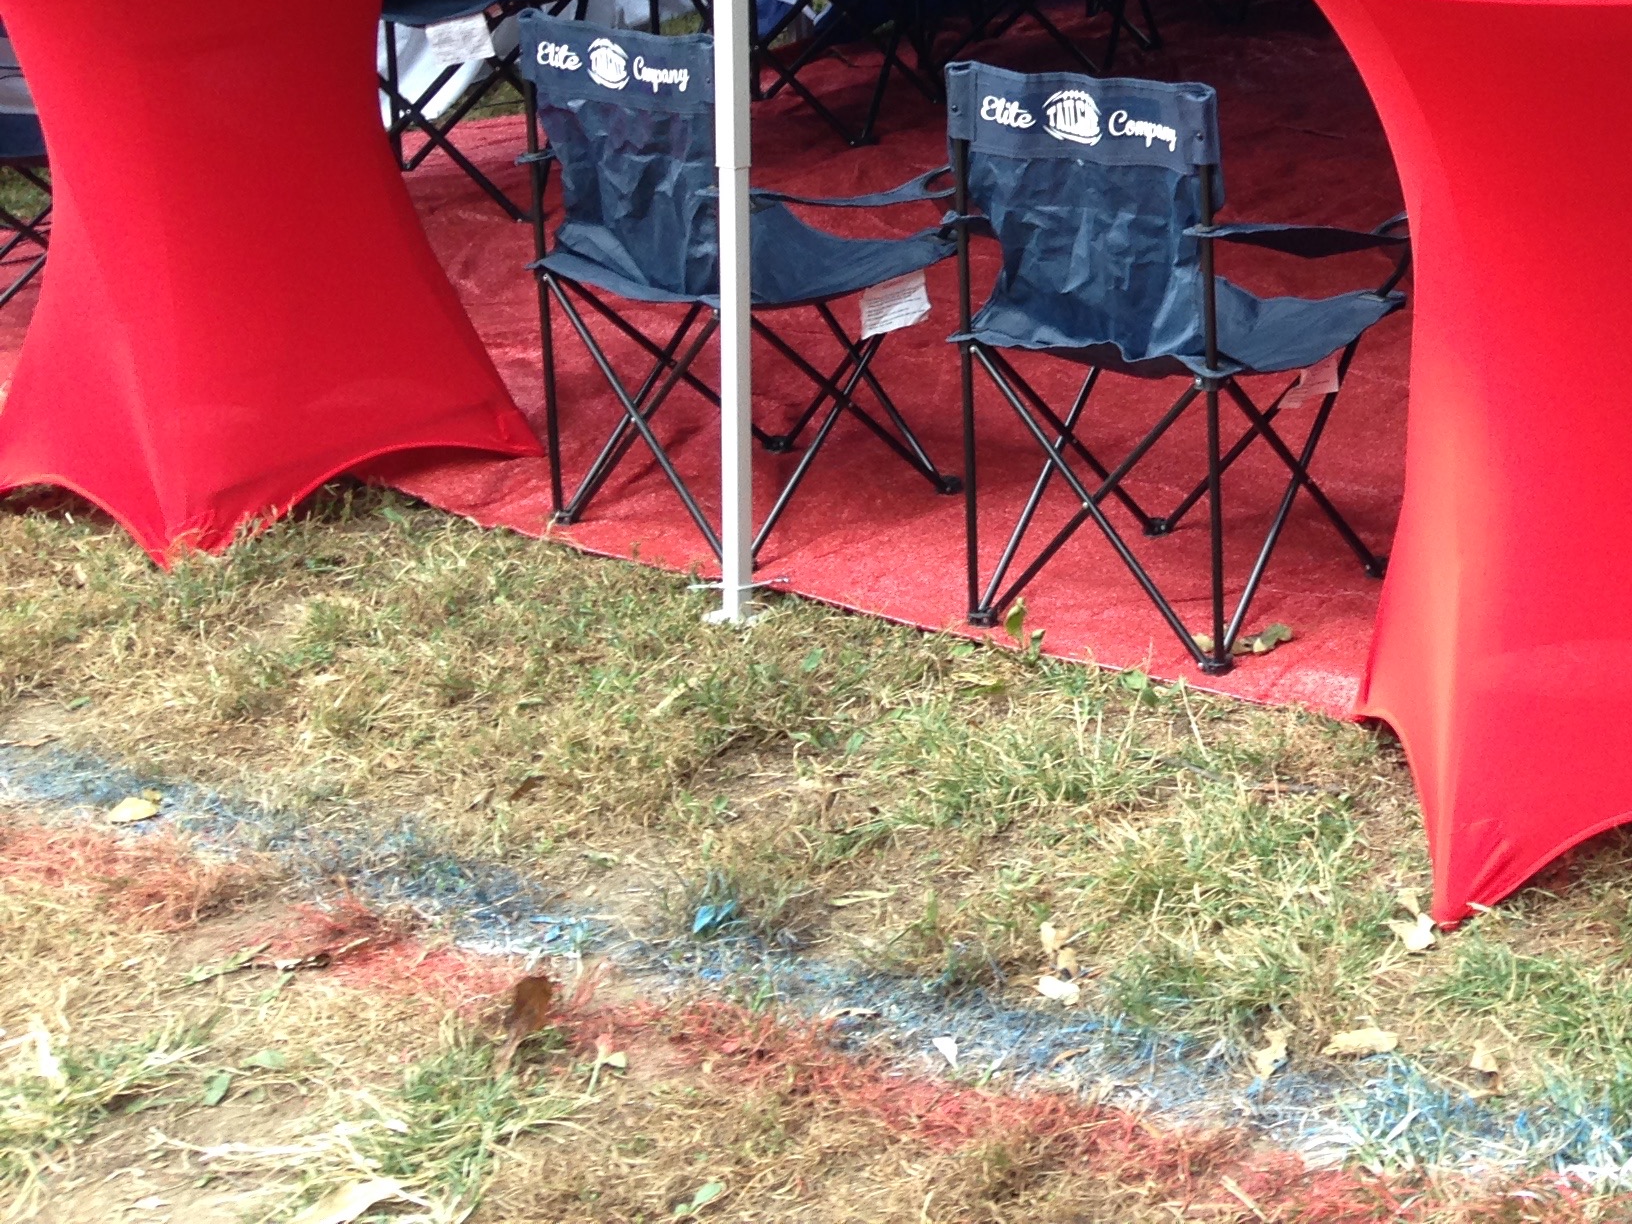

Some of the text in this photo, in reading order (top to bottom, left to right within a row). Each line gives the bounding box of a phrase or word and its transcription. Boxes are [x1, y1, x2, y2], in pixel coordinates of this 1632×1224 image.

[536, 41, 583, 70] Elite
[633, 56, 690, 93] Company
[980, 95, 1036, 128] Elite
[1108, 110, 1178, 152] Company
